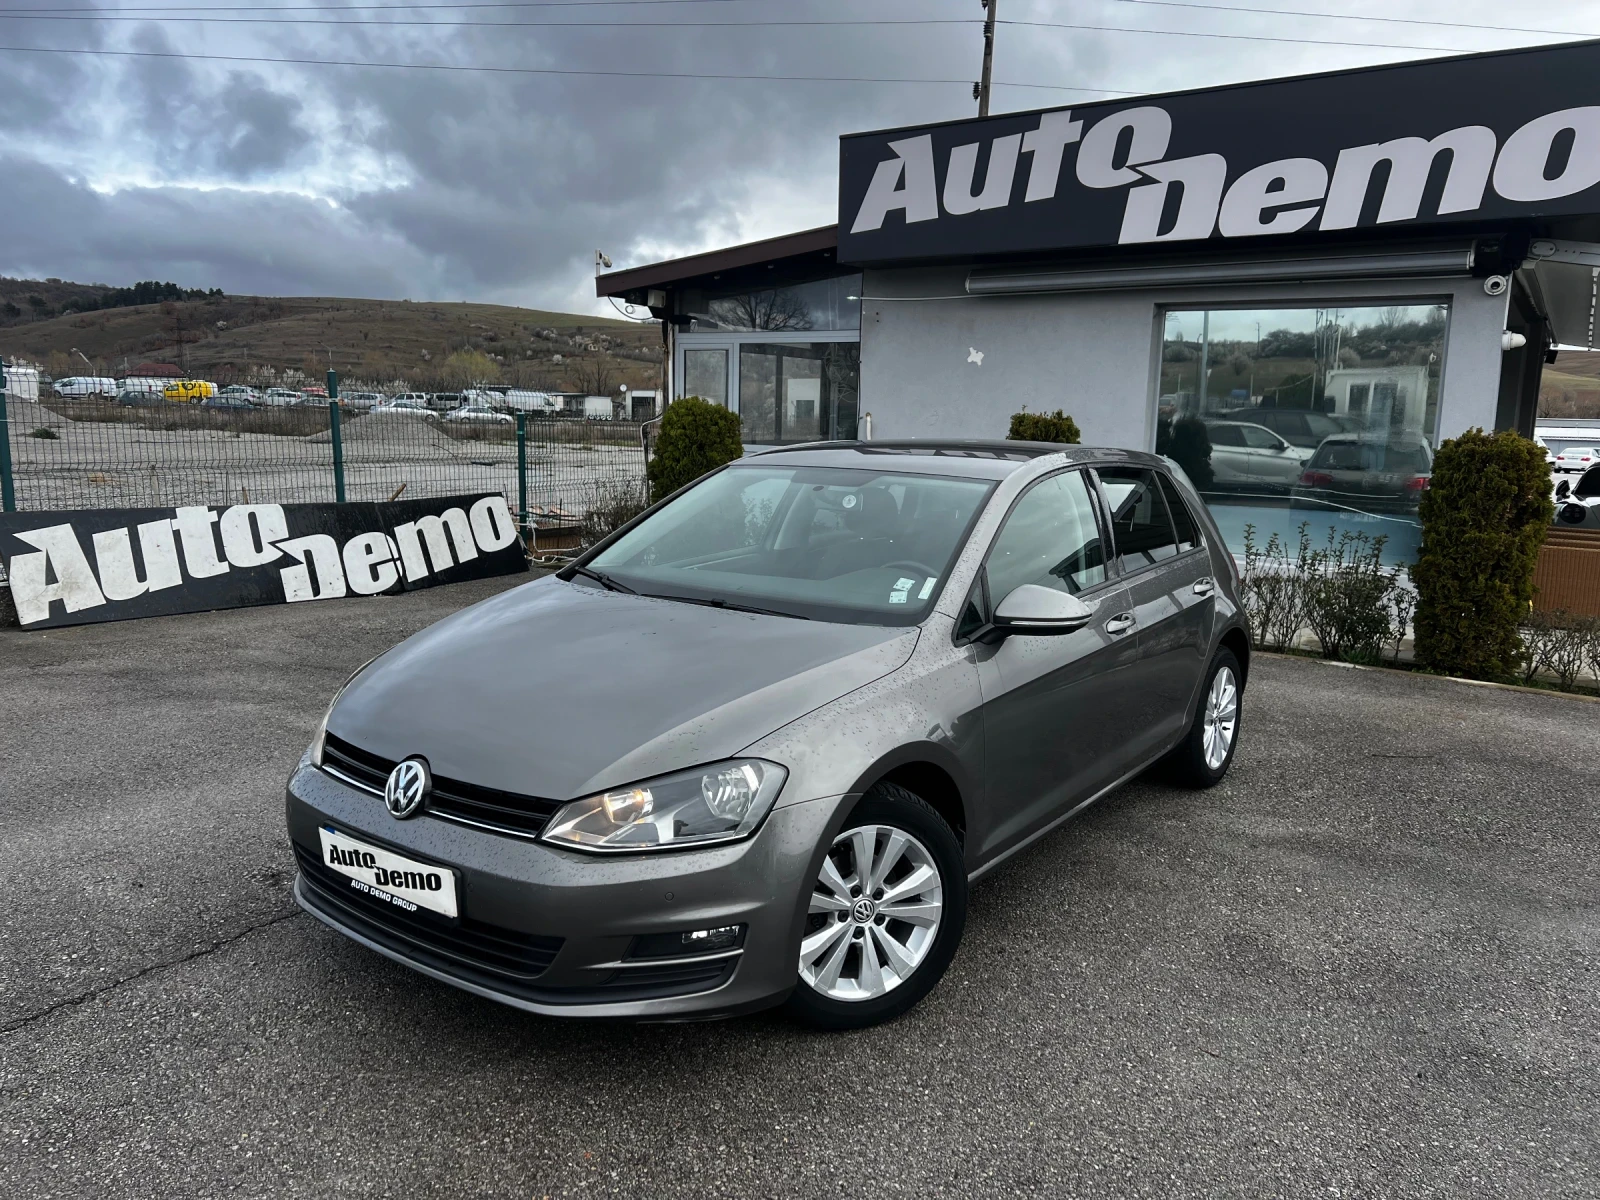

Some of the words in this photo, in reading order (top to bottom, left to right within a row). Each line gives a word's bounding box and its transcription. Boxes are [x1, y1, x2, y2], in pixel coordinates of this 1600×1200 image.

[850, 106, 1172, 234] Auto
[1118, 105, 1600, 244] Demo
[8, 503, 289, 625] Auto
[274, 496, 517, 603] Demo
[329, 844, 376, 869] Auto
[374, 865, 442, 892] Demo
[350, 879, 369, 893] AUTO
[370, 887, 392, 902] DEMO
[392, 896, 418, 912] GROUP
